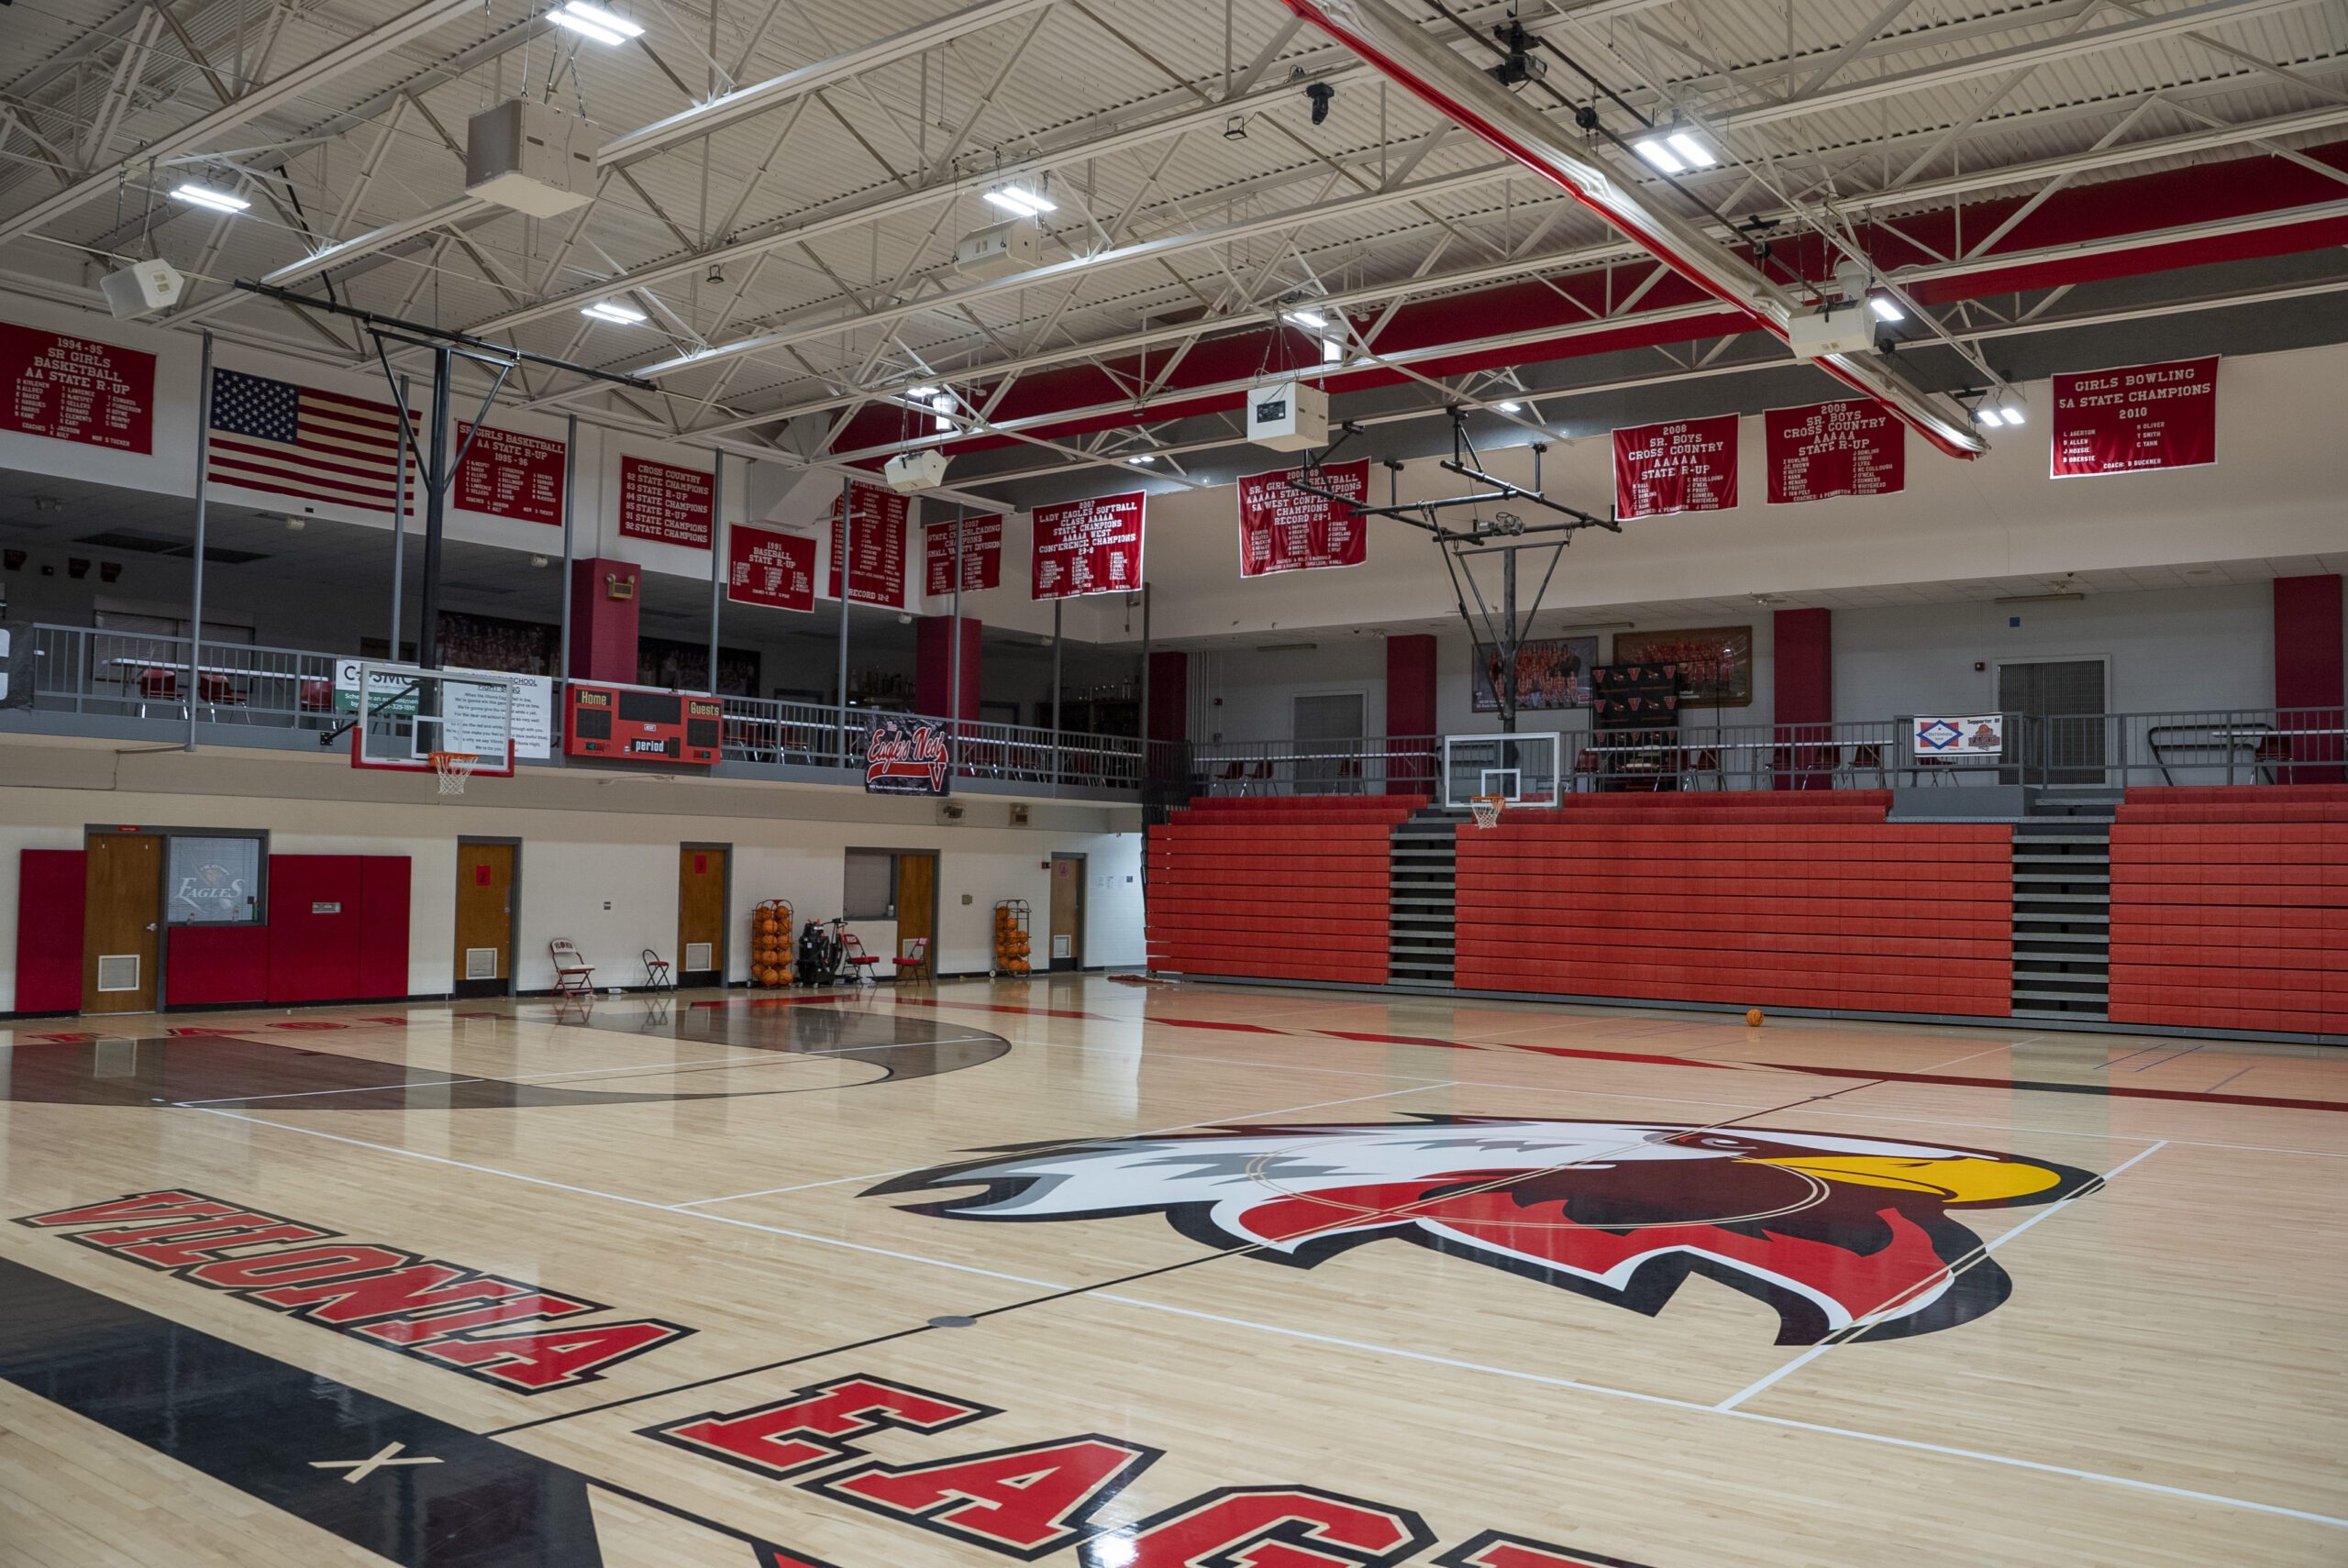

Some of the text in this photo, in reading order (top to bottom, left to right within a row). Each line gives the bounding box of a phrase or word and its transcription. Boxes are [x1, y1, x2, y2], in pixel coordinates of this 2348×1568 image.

[48, 348, 111, 368] SR GIRLS
[34, 357, 122, 381] BASKETBALL
[26, 367, 43, 379] AA
[50, 371, 90, 387] STATE
[2075, 369, 2195, 392] GIRLS BOWLING
[2059, 383, 2211, 409] 5A STATE CHAMPIONS
[1822, 403, 1846, 414] 2009
[2119, 407, 2147, 419] 2010
[1807, 411, 1861, 426] SR. BOYS
[1663, 425, 1687, 436] 2008
[1784, 417, 1886, 438] CROSS COUNTRY
[476, 428, 503, 440] GIRLS
[506, 435, 563, 454] BASKETBALL
[477, 439, 490, 448] AA
[493, 442, 521, 455] STATE
[1650, 434, 1702, 447] SR. BOYS
[1629, 441, 1723, 460] CROSS COUNTRY
[1799, 442, 1834, 457] STATE
[638, 465, 701, 483] CROSS COUNTRY
[1642, 468, 1676, 480] STATE
[637, 475, 662, 486] STATE
[665, 480, 709, 494] CHAMPIONS
[637, 485, 662, 495] STATE
[1249, 486, 1262, 494] SR.
[1267, 482, 1290, 491] GIRL
[637, 494, 662, 505] STATE
[665, 500, 707, 513] CHAMPIONS
[1247, 491, 1276, 503] AAAAA
[636, 504, 662, 514] STATE
[1040, 502, 1137, 523] LADY EAGLES SOFTBALL
[1252, 500, 1289, 512] 5A WEST
[1277, 503, 1328, 516] CHAMPIONS
[636, 513, 662, 525] STATE
[665, 519, 707, 533] CHAMPIONS
[1061, 517, 1084, 526] CLASS
[1275, 514, 1309, 525] RECORD
[635, 524, 661, 535] STATE
[664, 529, 707, 543] CHAMPIONS
[1054, 520, 1122, 536] STATE CHAMPIONS
[1091, 529, 1111, 537] WEST
[928, 534, 947, 542] STATE
[975, 541, 1001, 550] DIVISION
[1039, 534, 1135, 553] CONFERENCE CHAMPIONS
[749, 555, 772, 565] STATE
[753, 547, 792, 560] BASEBALL
[848, 589, 875, 599] RECORD
[511, 678, 537, 687] CHOOL
[581, 691, 606, 706] Home
[691, 701, 719, 716] Guests
[636, 741, 664, 752] period
[928, 762, 947, 791] V
[8, 1188, 701, 1397] VILONIA
[632, 1373, 1658, 1568] EAG
